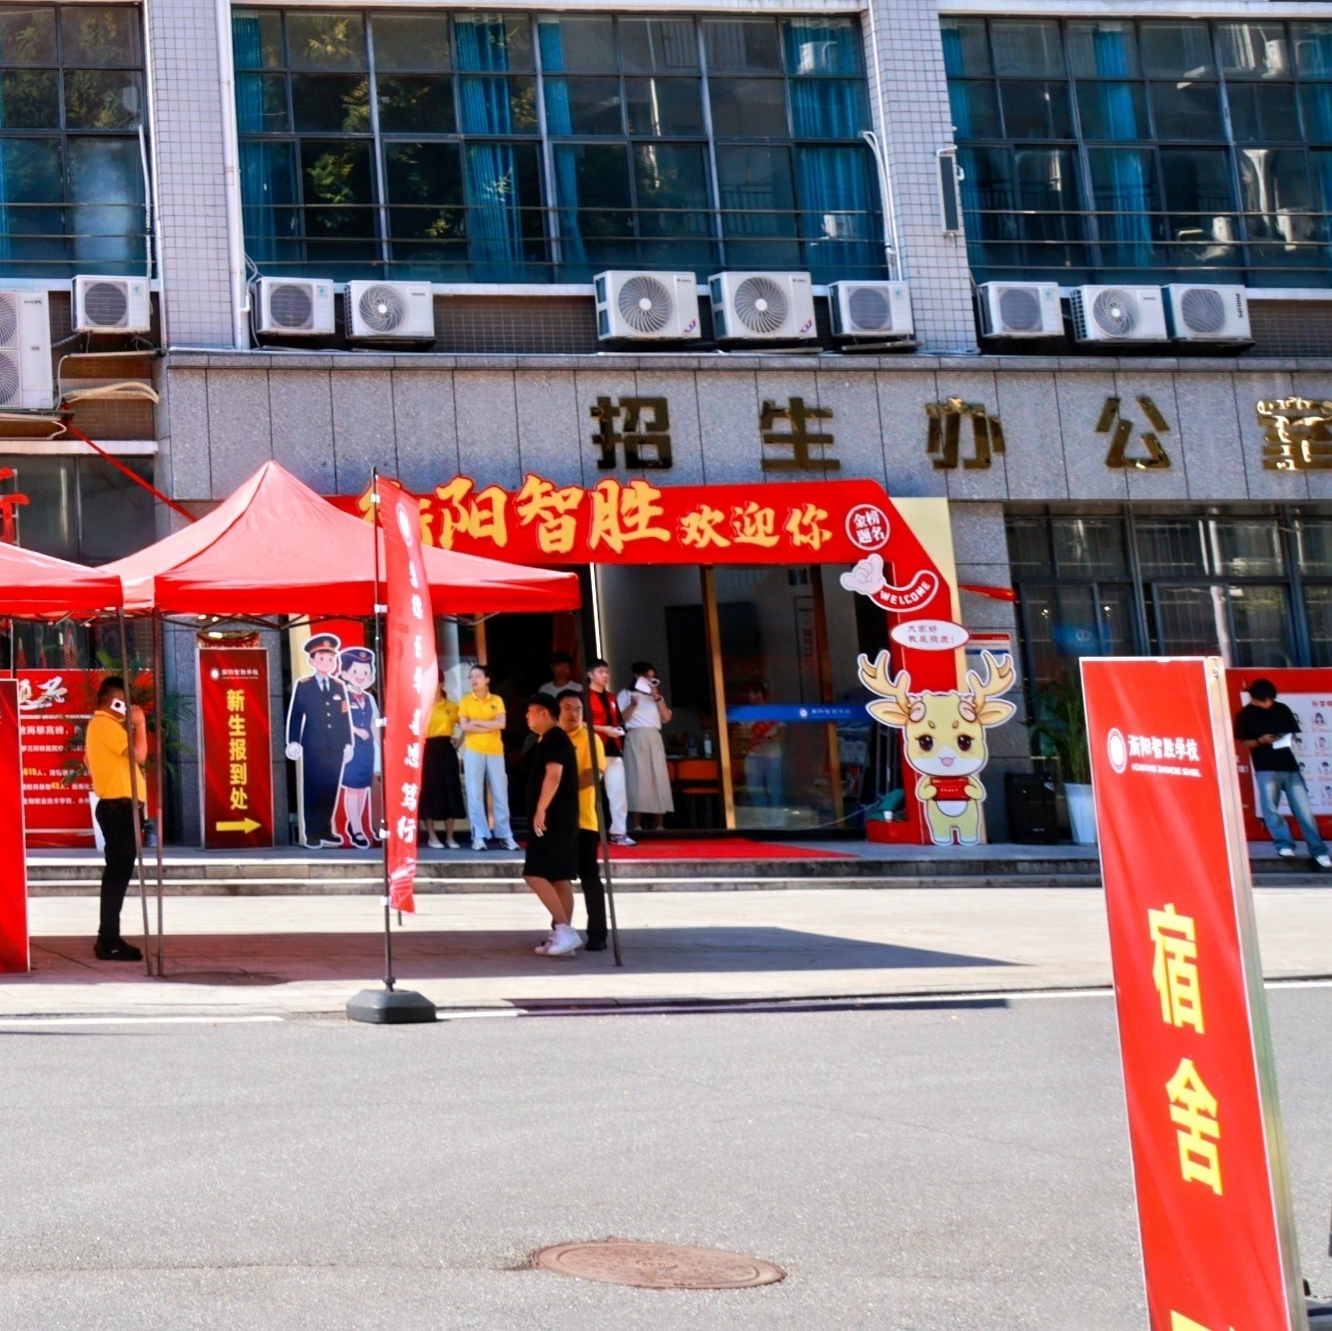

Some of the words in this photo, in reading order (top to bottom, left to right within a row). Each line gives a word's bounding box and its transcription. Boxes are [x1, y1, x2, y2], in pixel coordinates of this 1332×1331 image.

[590, 396, 1332, 471] 招生办公室
[679, 501, 833, 552] 欢迎你
[853, 510, 881, 528] 金榜
[856, 526, 885, 544] 题名
[880, 580, 931, 605] WELCOME
[226, 689, 249, 811] 新生报到处
